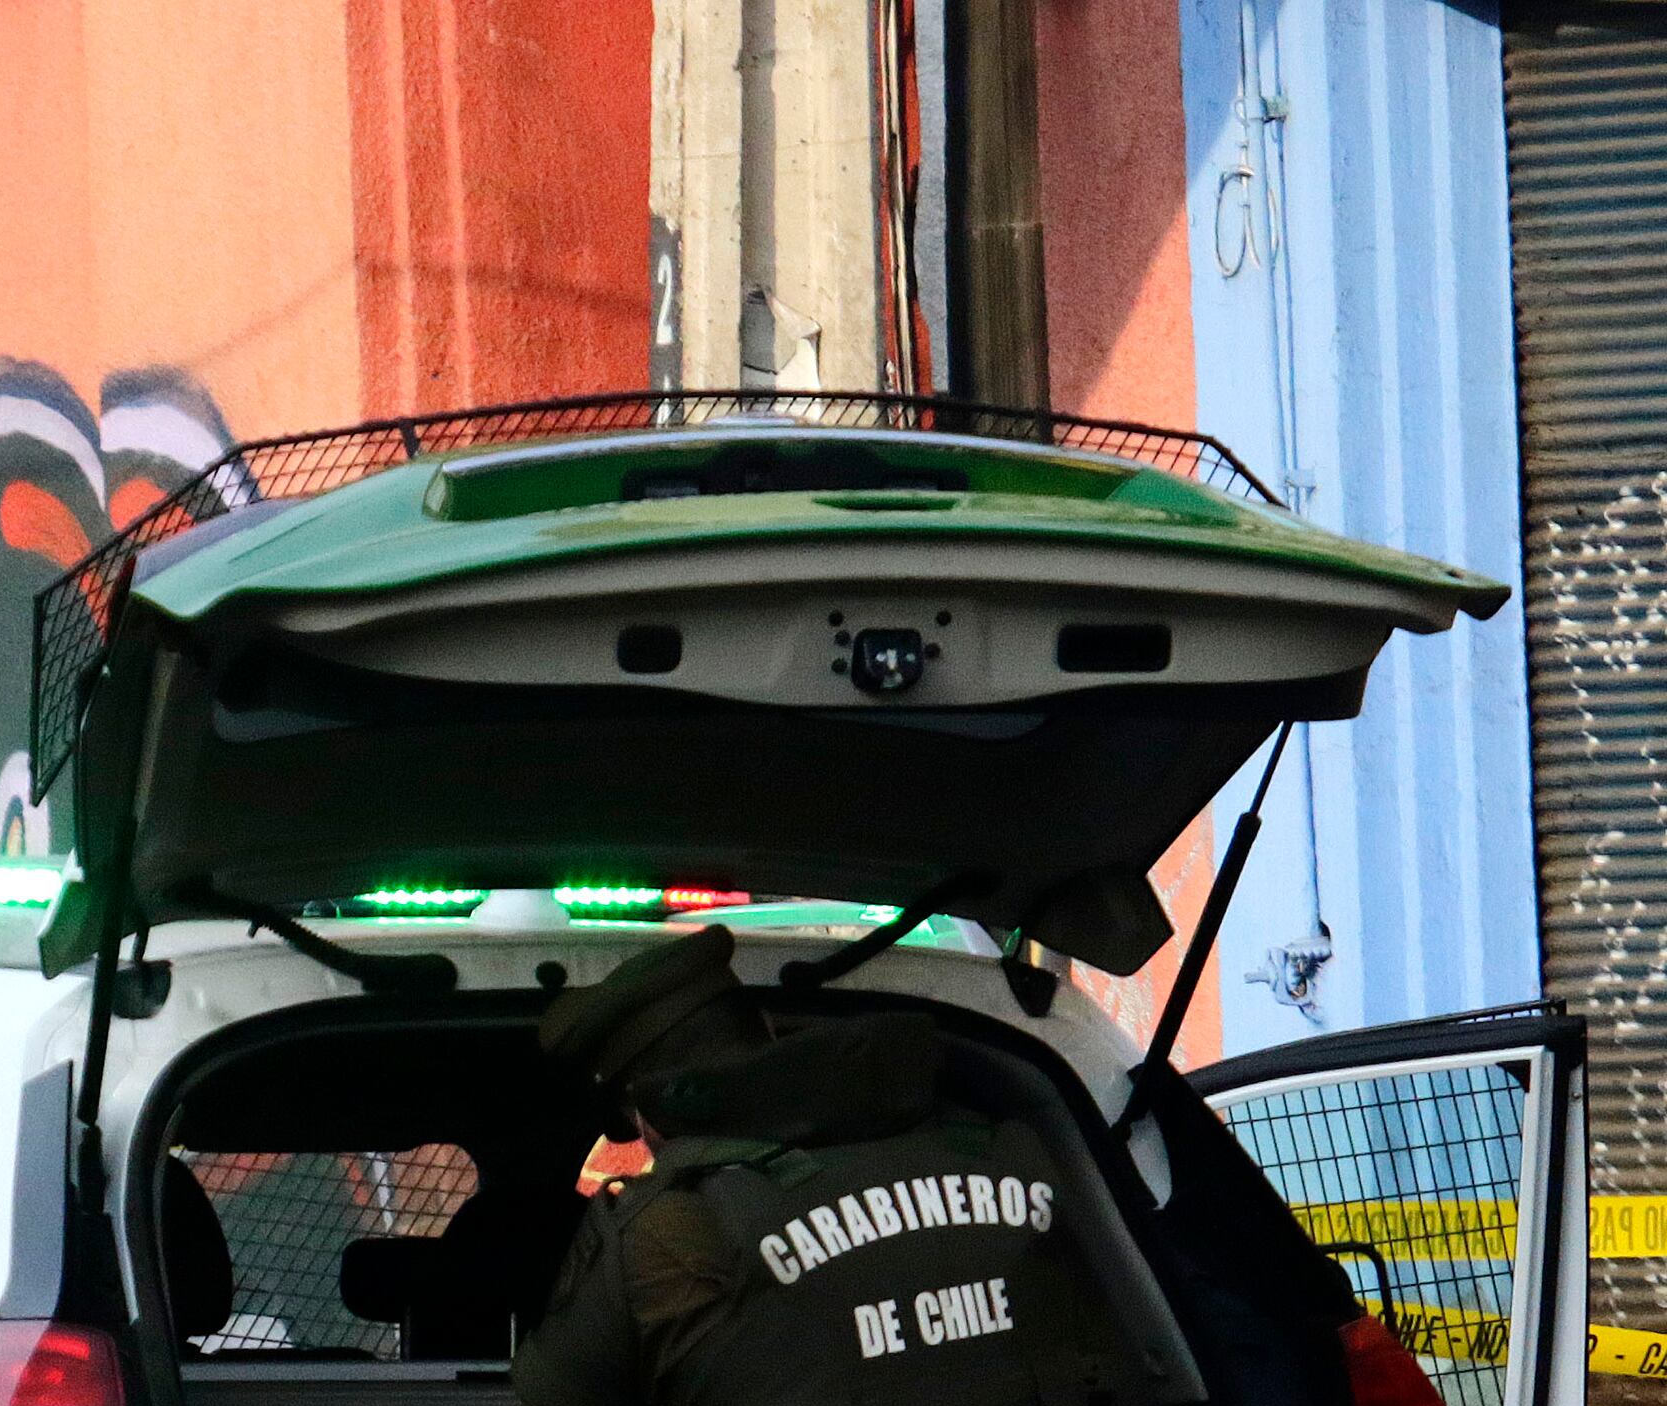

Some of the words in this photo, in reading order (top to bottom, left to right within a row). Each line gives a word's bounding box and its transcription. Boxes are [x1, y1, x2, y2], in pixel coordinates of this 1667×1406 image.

[759, 1173, 1055, 1286] CARABINEROS
[854, 1299, 907, 1359] DE
[914, 1277, 1014, 1346] CHILE
